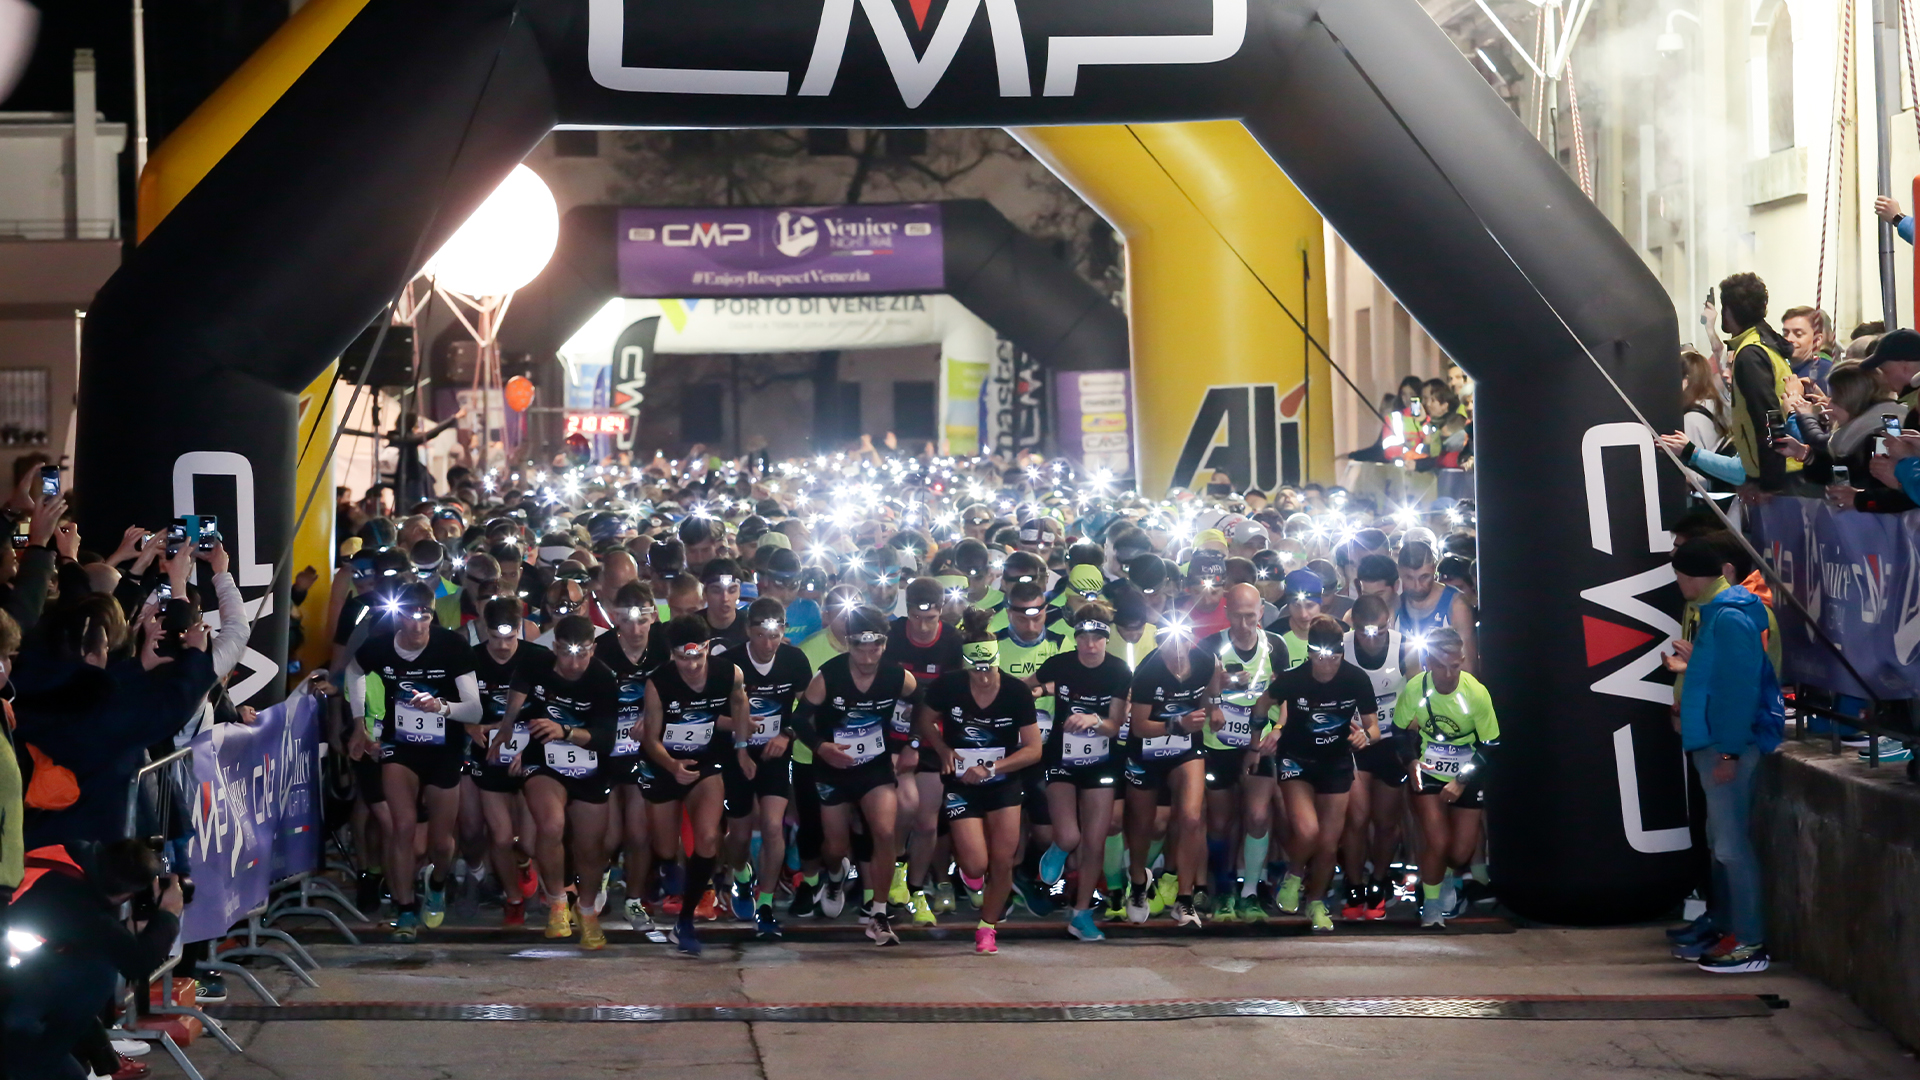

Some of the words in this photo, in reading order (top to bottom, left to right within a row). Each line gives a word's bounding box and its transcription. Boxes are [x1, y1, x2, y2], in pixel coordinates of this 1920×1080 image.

[824, 217, 898, 237] Venice
[661, 222, 751, 249] CMP
[692, 269, 871, 287] #EnjoyRespectVenezia
[713, 299, 792, 316] PORTO
[800, 298, 820, 315] DI
[828, 295, 926, 313] VENEZIA
[1166, 375, 1310, 497] Ali
[415, 717, 424, 730] 3
[406, 734, 433, 742] CMP
[685, 730, 694, 741] 2
[1315, 735, 1339, 745] CMP
[673, 744, 699, 752] CMP
[856, 743, 865, 754] 9
[1083, 743, 1092, 755] 6
[1154, 749, 1181, 757] CMP
[567, 751, 576, 763] 5
[1074, 757, 1100, 766] CMP
[560, 768, 587, 777] CMP
[1435, 761, 1460, 773] 878
